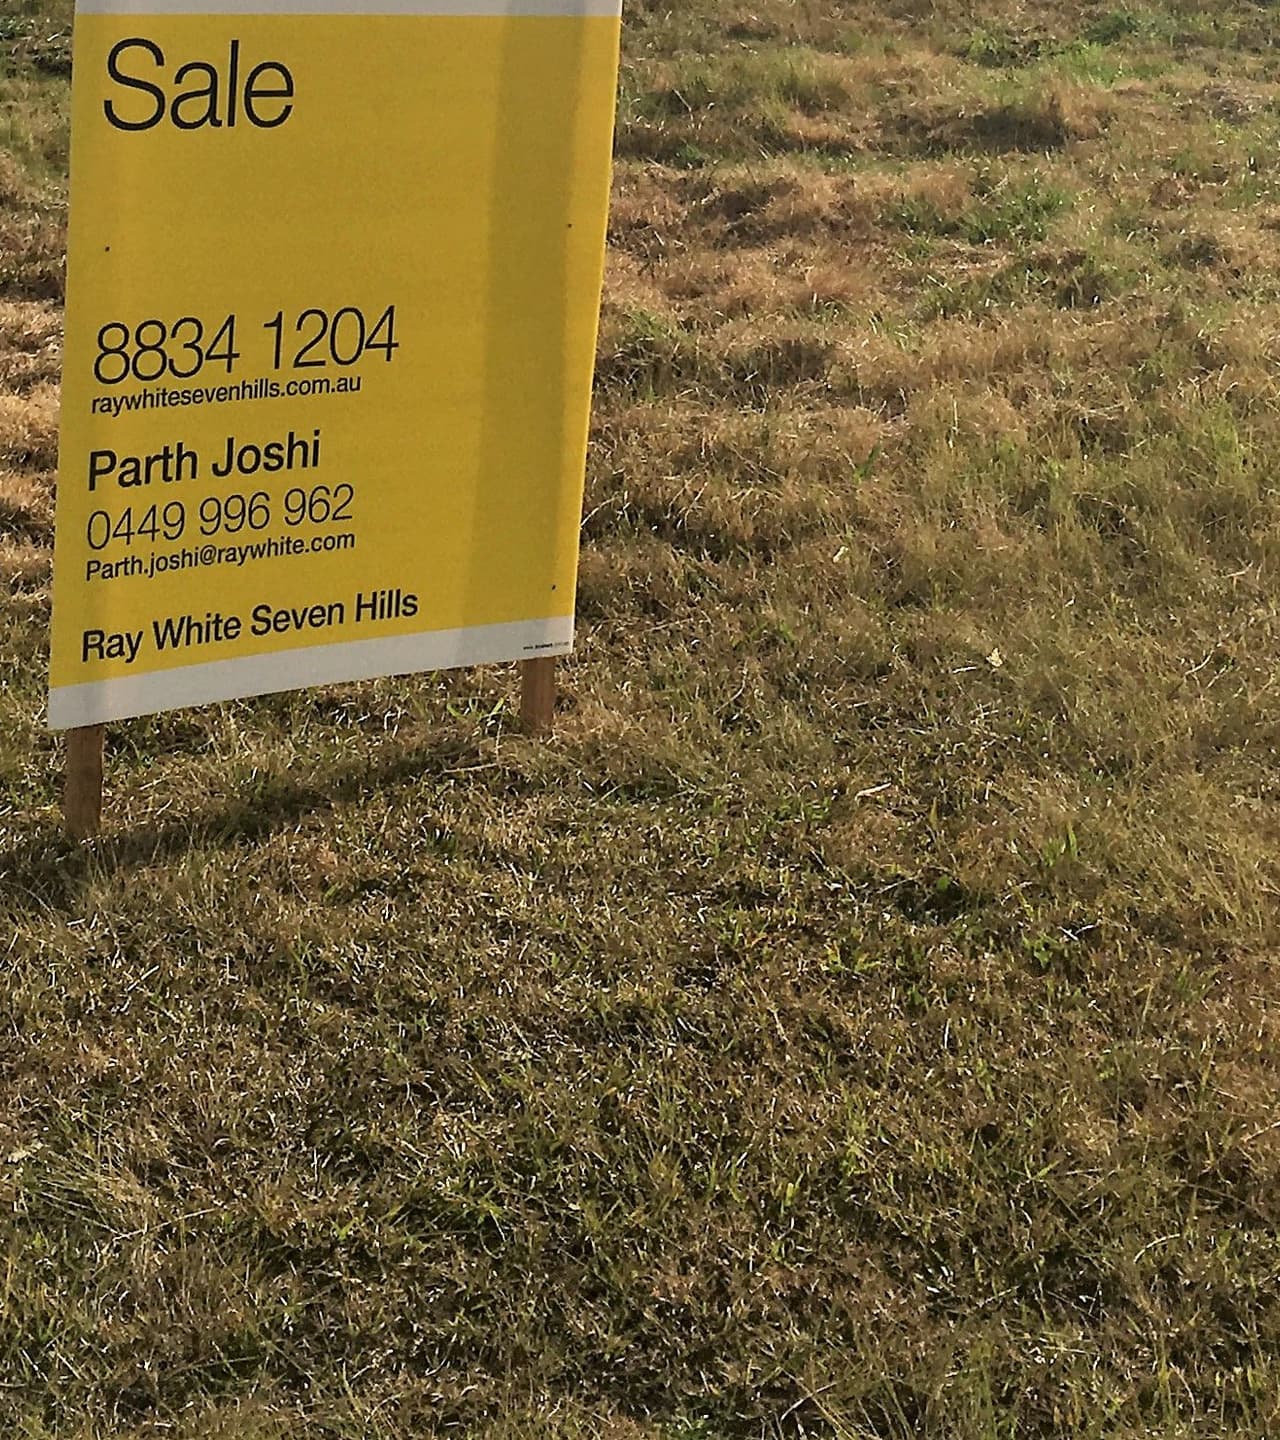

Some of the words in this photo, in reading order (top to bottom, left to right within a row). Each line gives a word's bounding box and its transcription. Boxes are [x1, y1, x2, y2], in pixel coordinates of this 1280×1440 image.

[103, 37, 295, 132] Sale
[93, 314, 241, 385] 8834
[263, 304, 400, 370] 1204
[91, 375, 362, 417] raywhitesevenhills.com.au
[87, 441, 199, 492] Parth
[211, 429, 322, 478] Joshi
[86, 501, 186, 551] 0449
[199, 491, 271, 537] 996
[284, 483, 355, 527] 962
[85, 532, 356, 582] Parth.joshi@raywhite.com
[82, 630, 144, 663] Ray
[152, 612, 242, 651] White
[250, 597, 346, 637] Seven
[355, 588, 419, 624] Hills
